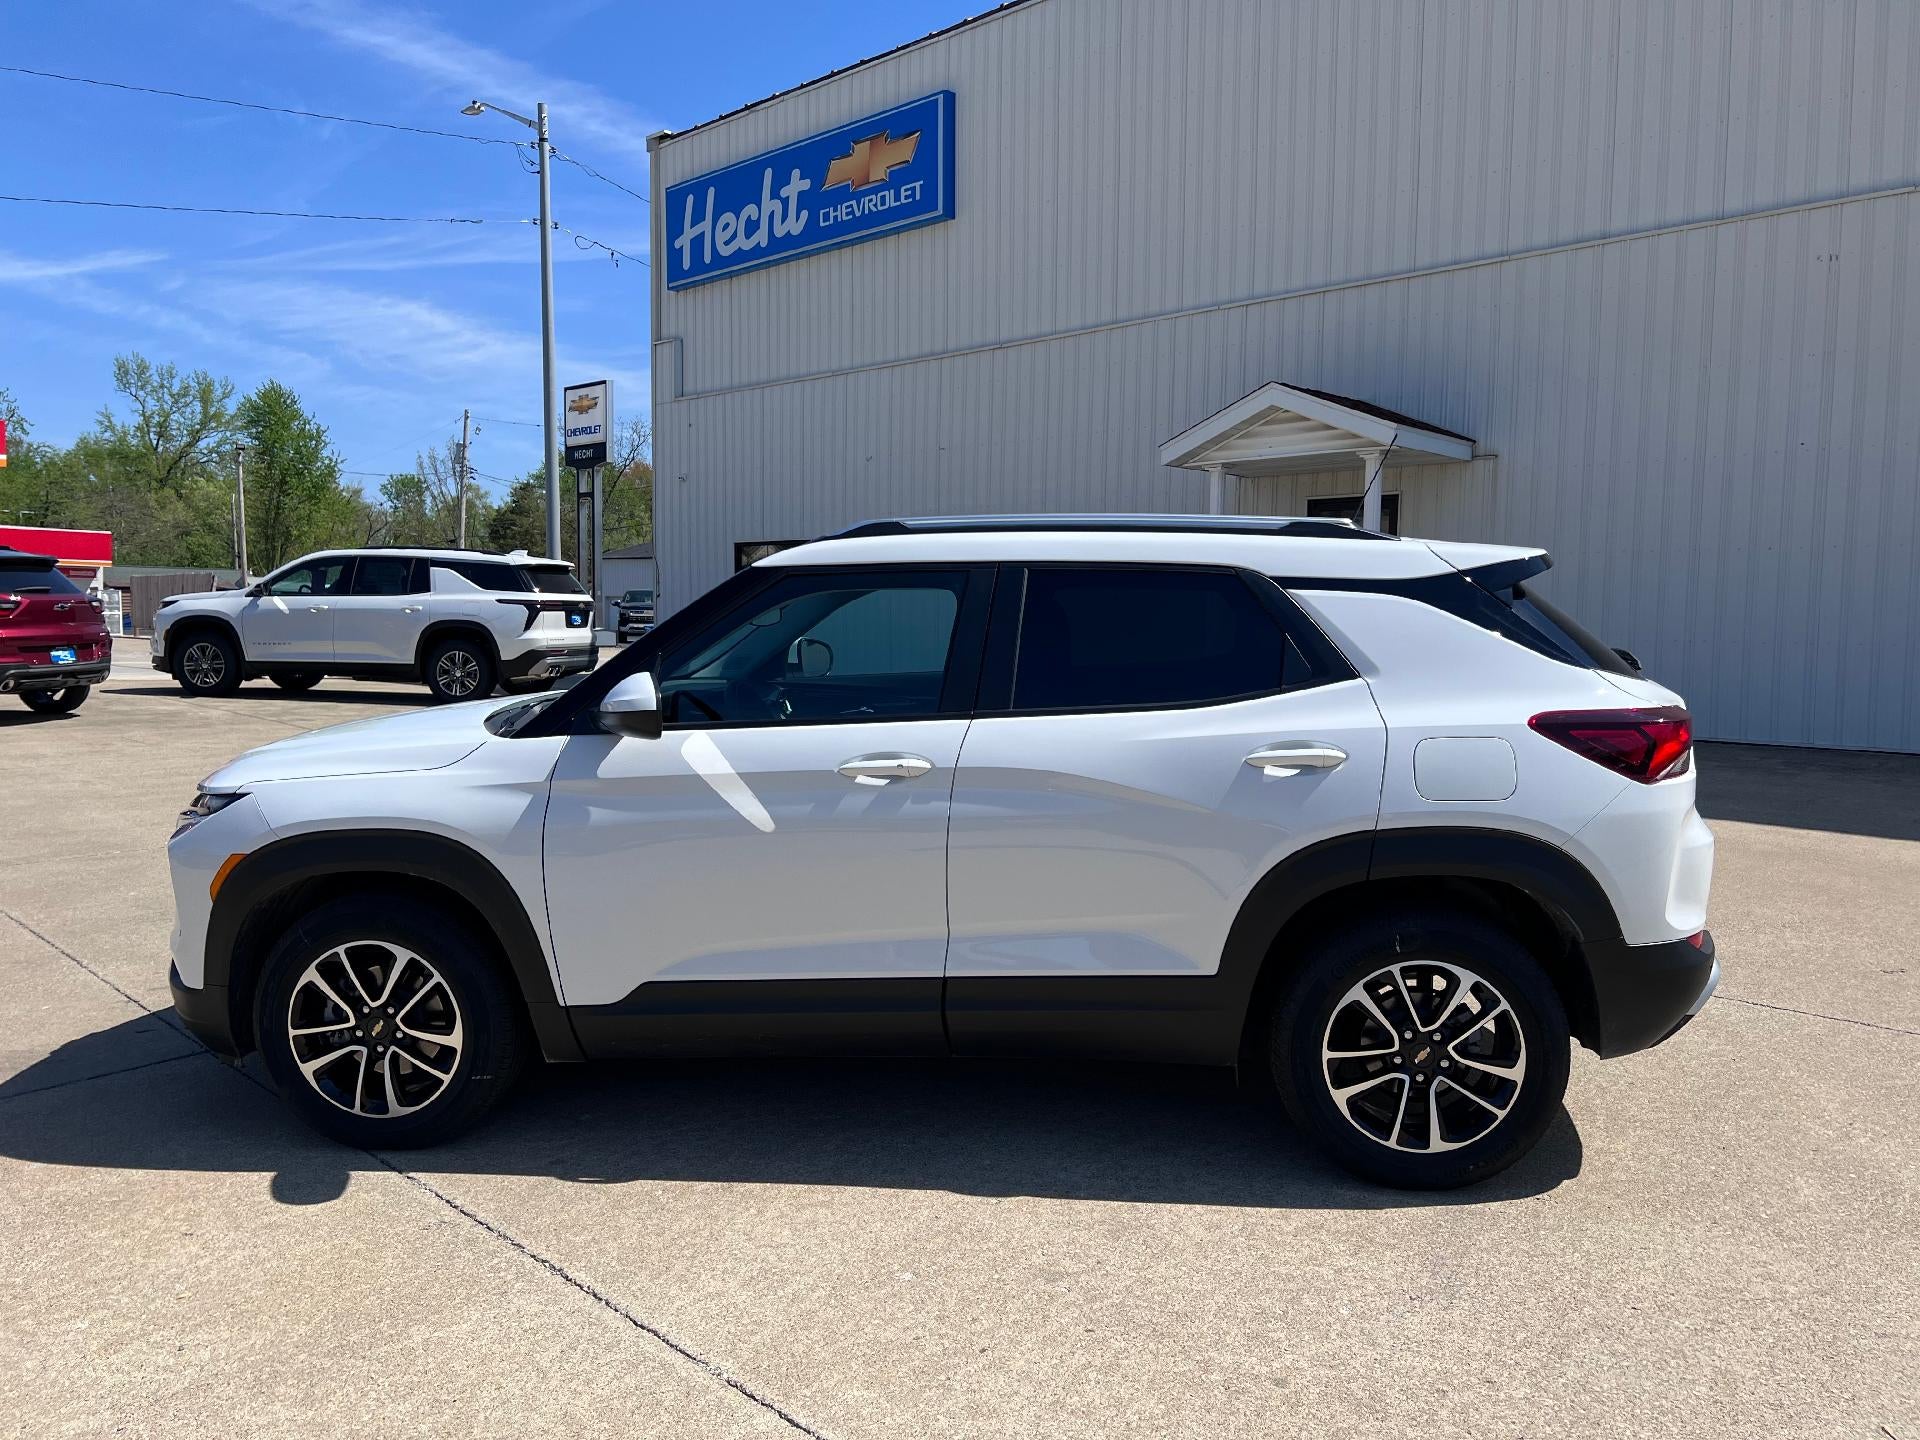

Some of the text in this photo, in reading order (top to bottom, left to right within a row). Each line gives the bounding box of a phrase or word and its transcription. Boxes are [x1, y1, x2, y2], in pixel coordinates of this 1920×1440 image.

[819, 180, 923, 227] CHEVROLET
[674, 167, 811, 270] Hecht
[567, 425, 601, 437] CHEVROLET
[574, 449, 593, 459] HECHT
